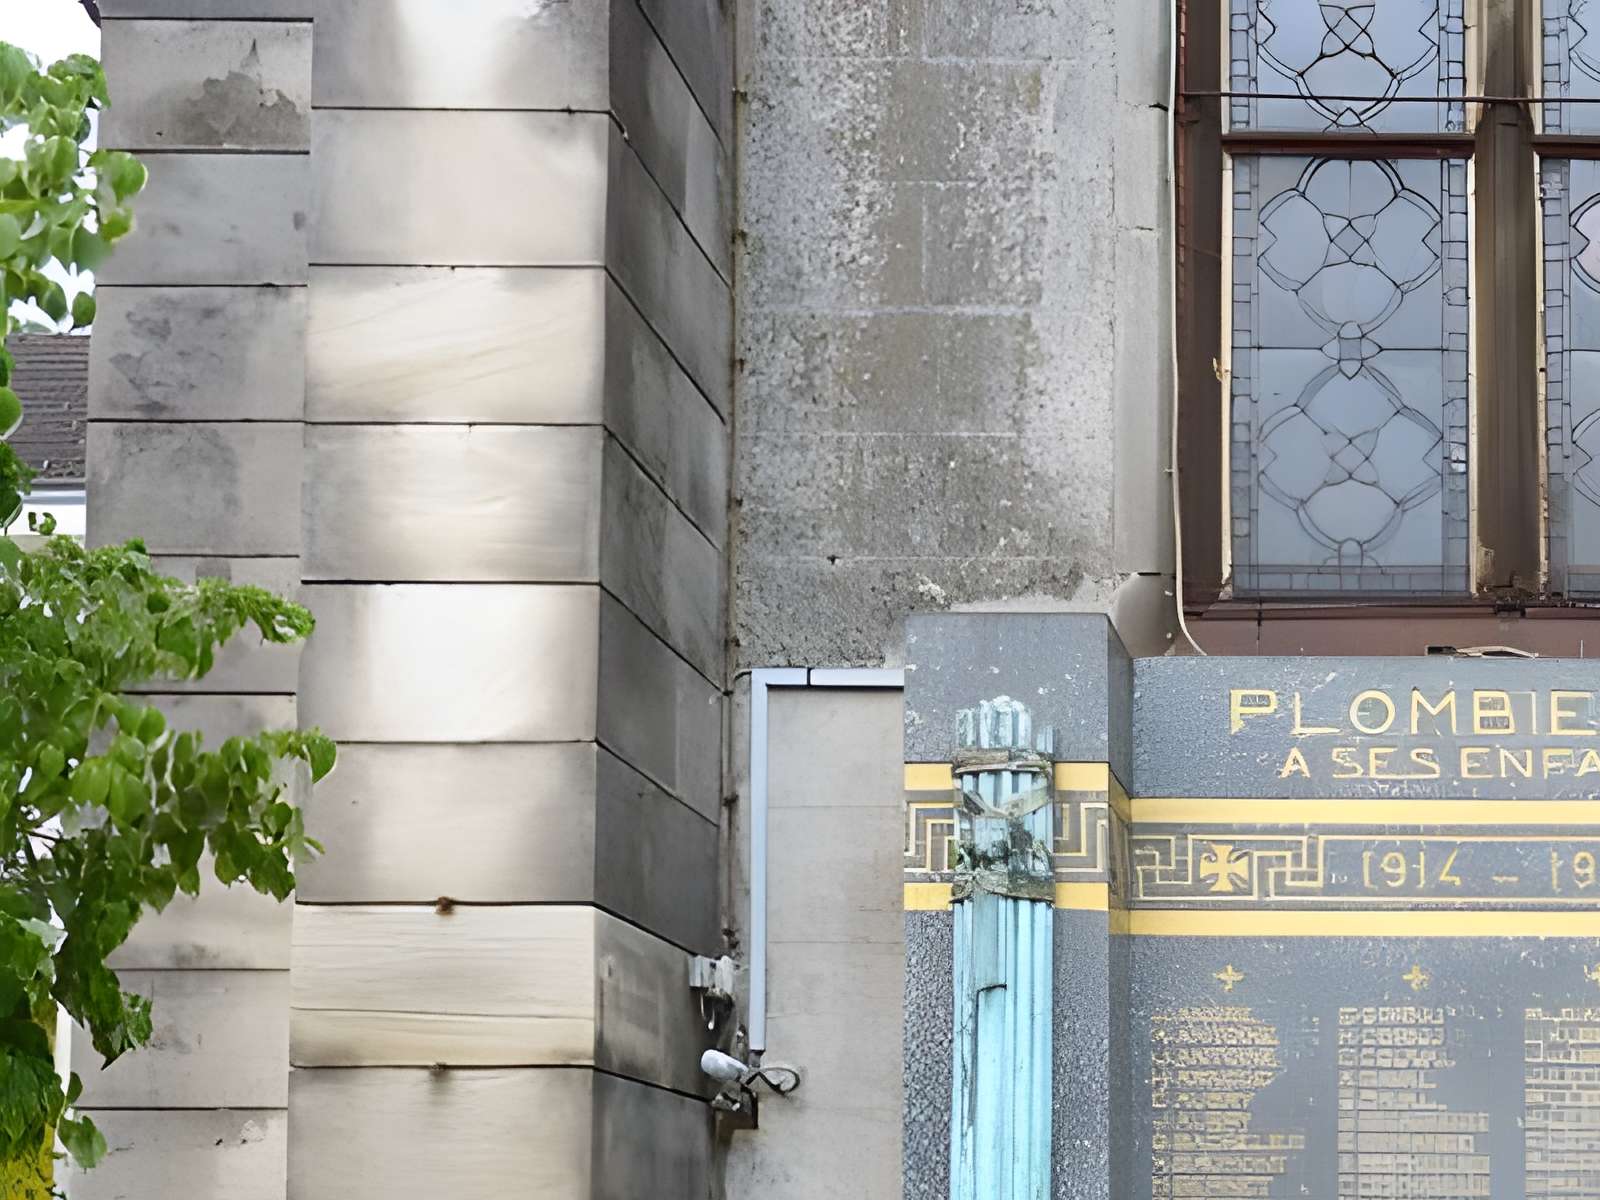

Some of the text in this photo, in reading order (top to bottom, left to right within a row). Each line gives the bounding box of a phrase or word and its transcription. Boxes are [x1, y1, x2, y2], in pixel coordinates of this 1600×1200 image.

[1279, 747, 1311, 778] A
[1331, 747, 1441, 779] SES
[1362, 848, 1462, 889] 1914
